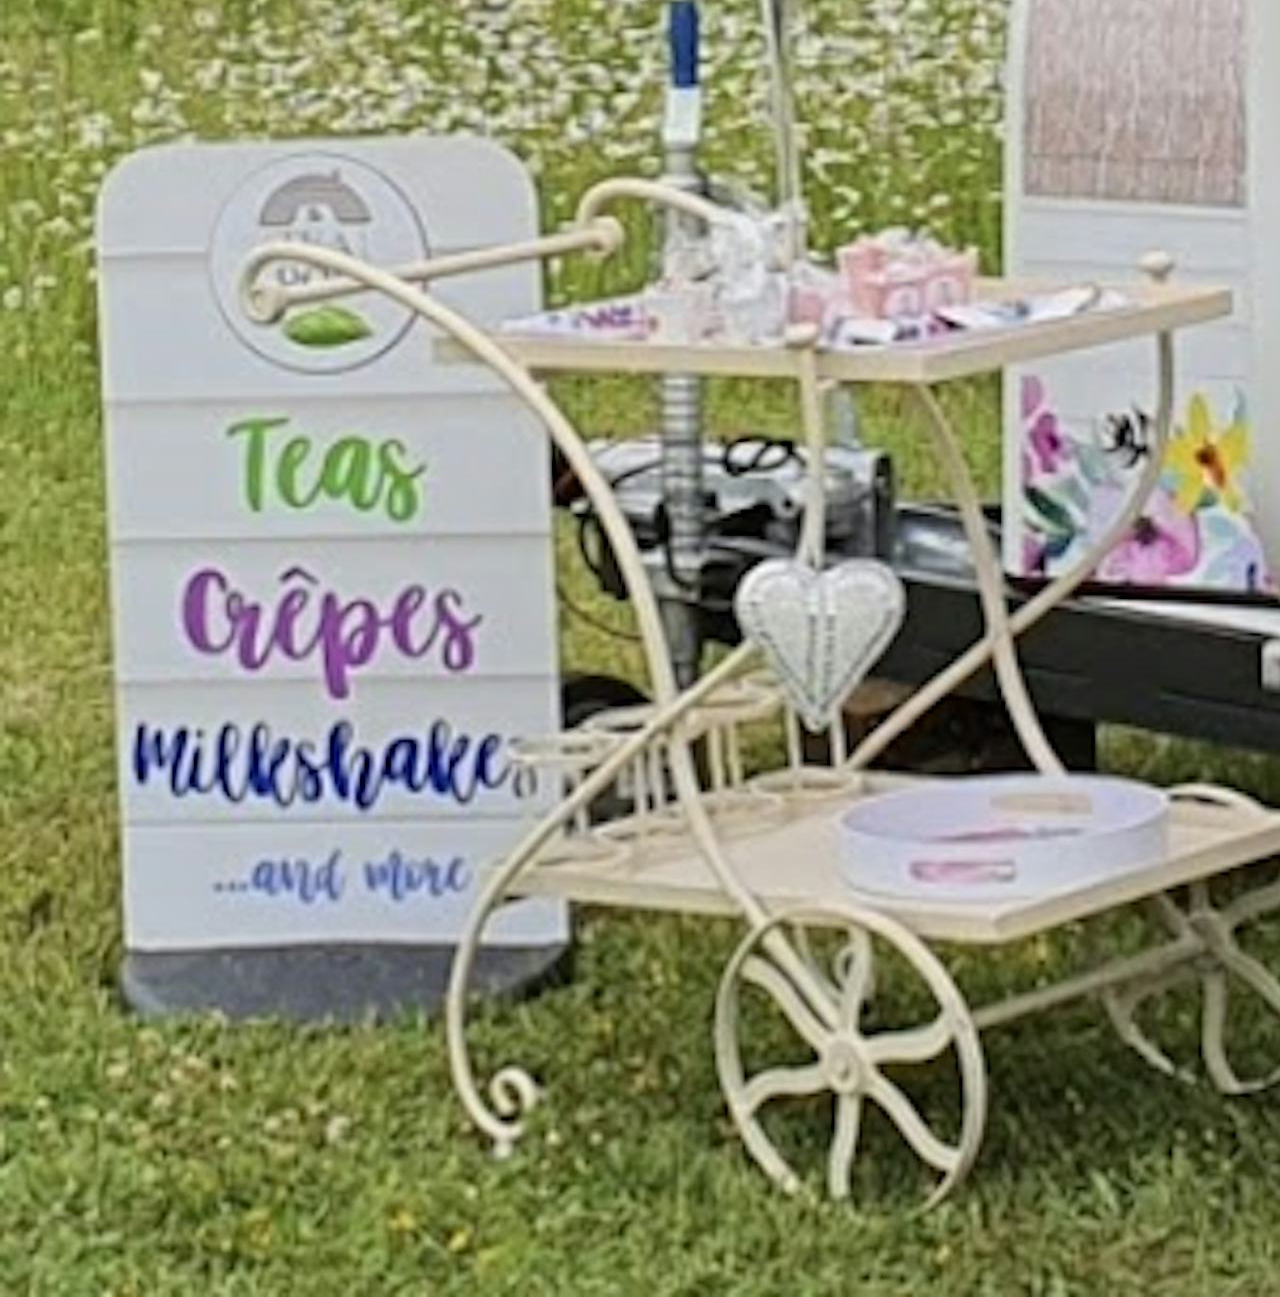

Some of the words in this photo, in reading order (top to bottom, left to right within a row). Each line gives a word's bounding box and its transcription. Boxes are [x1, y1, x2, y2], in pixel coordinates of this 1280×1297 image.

[226, 418, 426, 524] Teas
[183, 565, 483, 700] Crêpes
[364, 850, 470, 898] more
